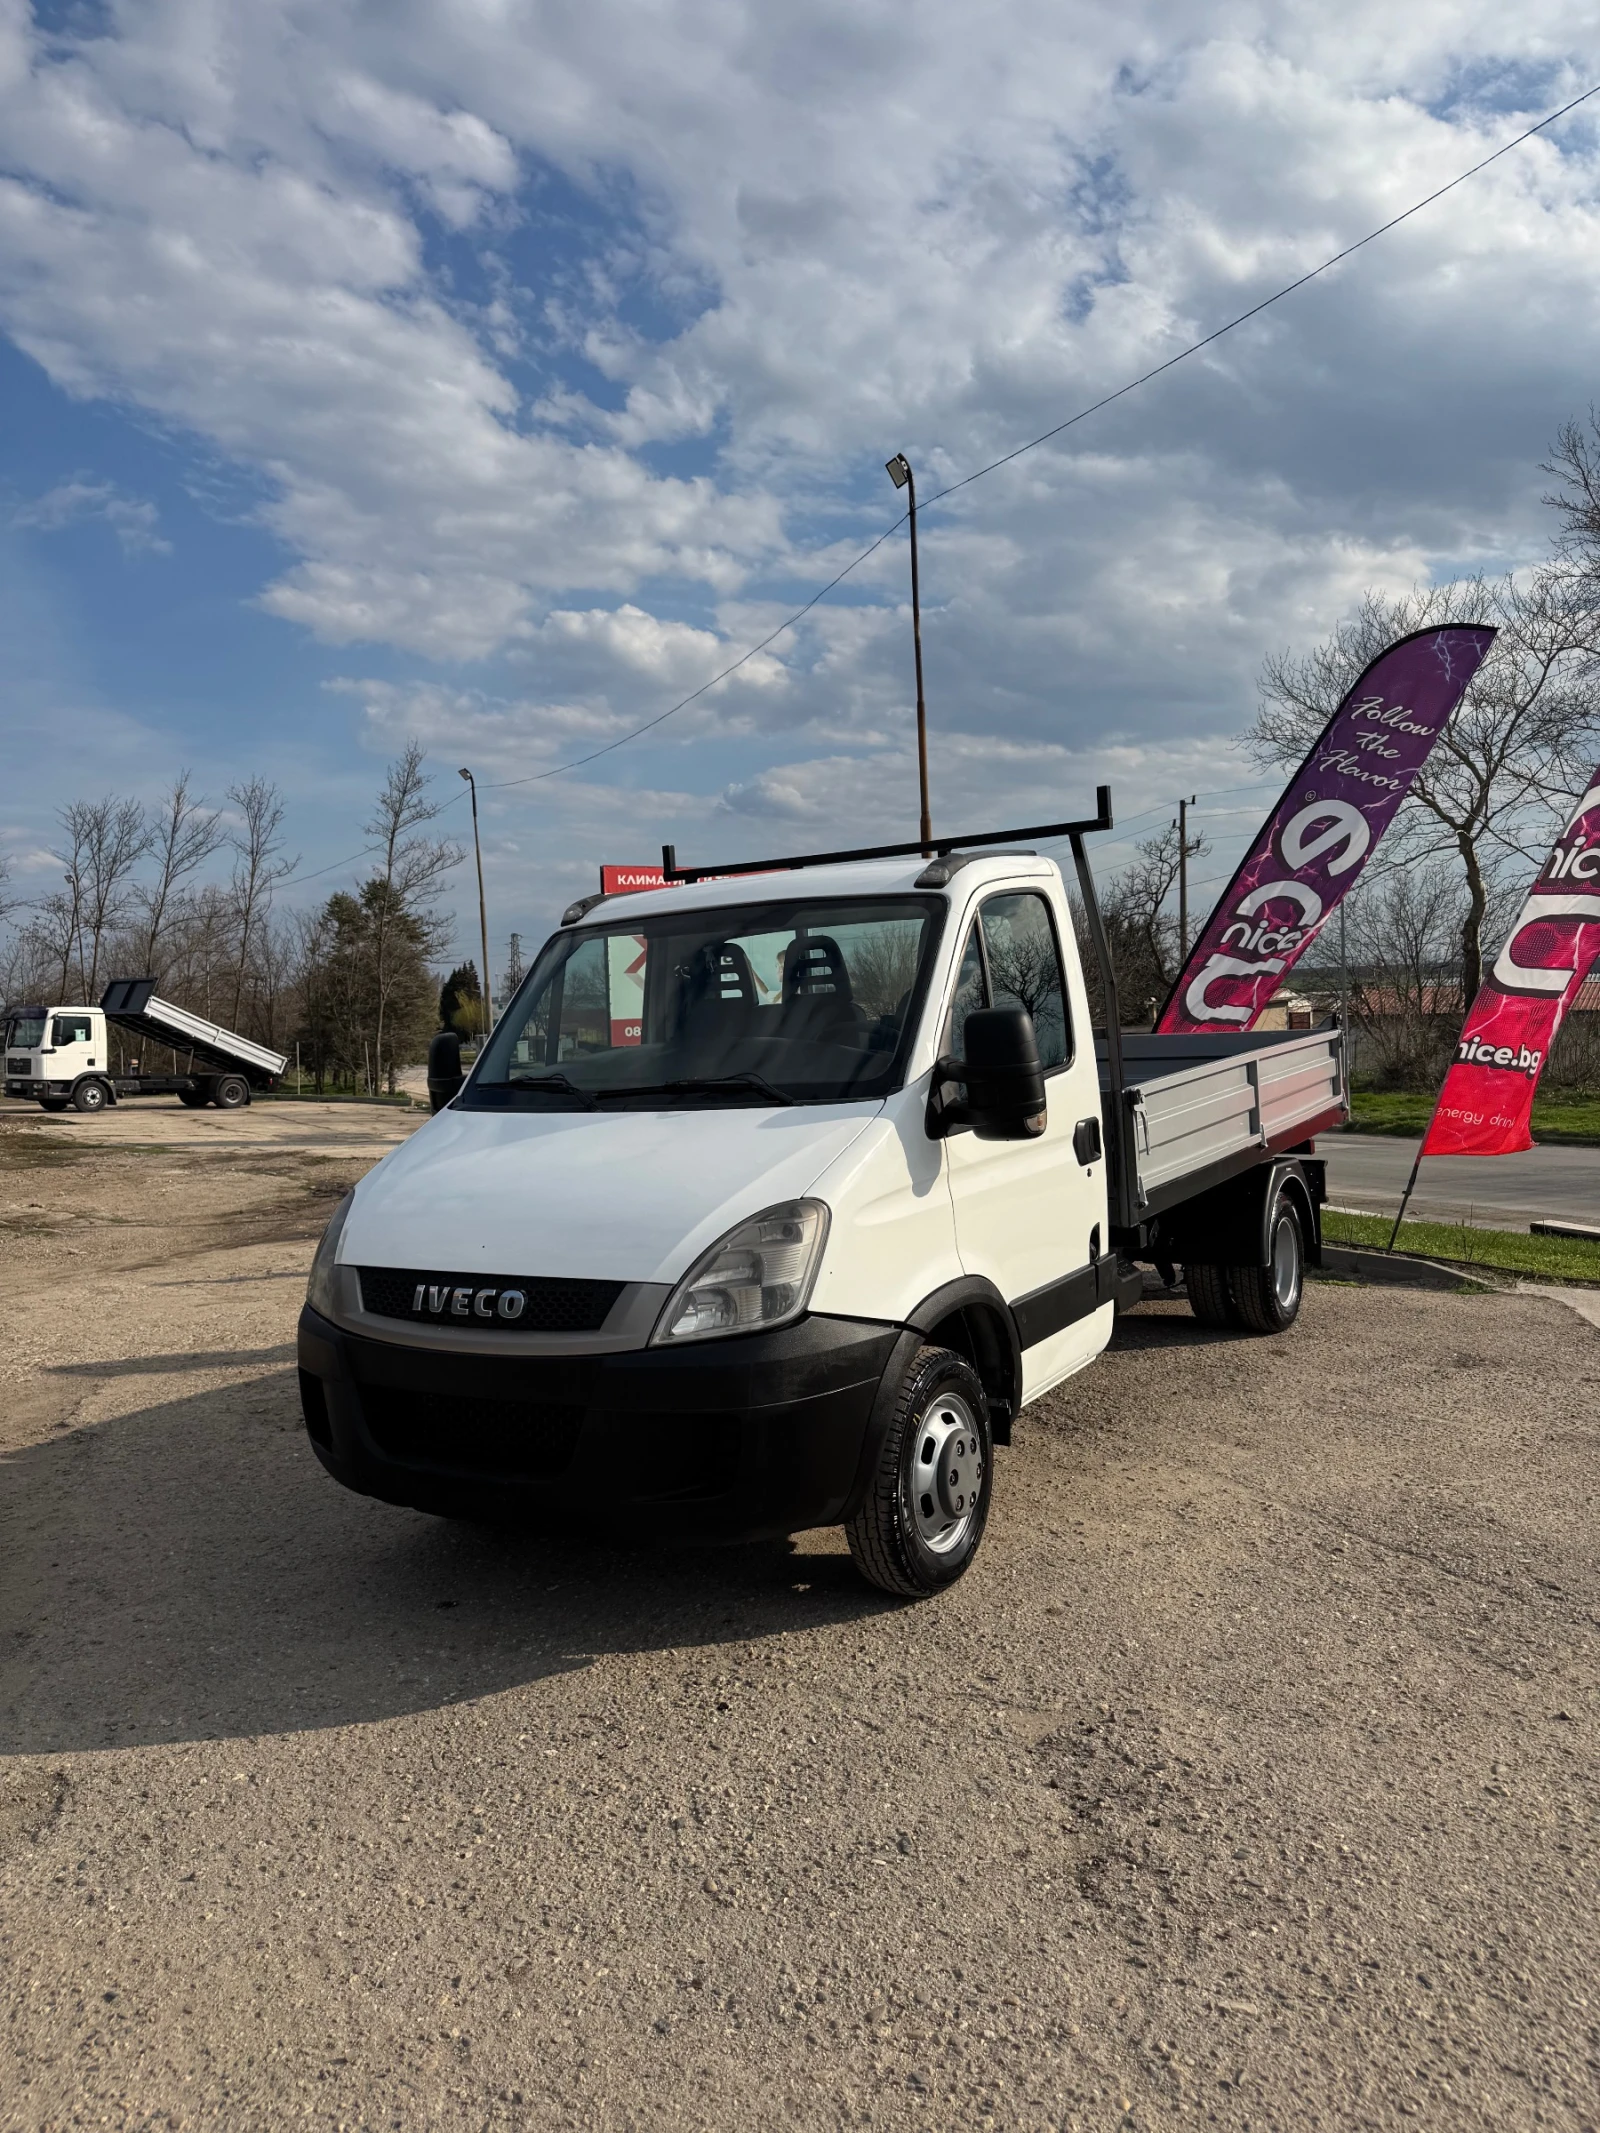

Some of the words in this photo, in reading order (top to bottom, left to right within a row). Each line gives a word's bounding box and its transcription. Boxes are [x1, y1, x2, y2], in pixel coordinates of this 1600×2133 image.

[1350, 696, 1435, 735] Follow
[1356, 732, 1401, 758] the
[1319, 749, 1404, 790] Flavor
[1548, 836, 1600, 879] nic
[624, 1026, 642, 1037] 08
[412, 1284, 525, 1319] IVECO
